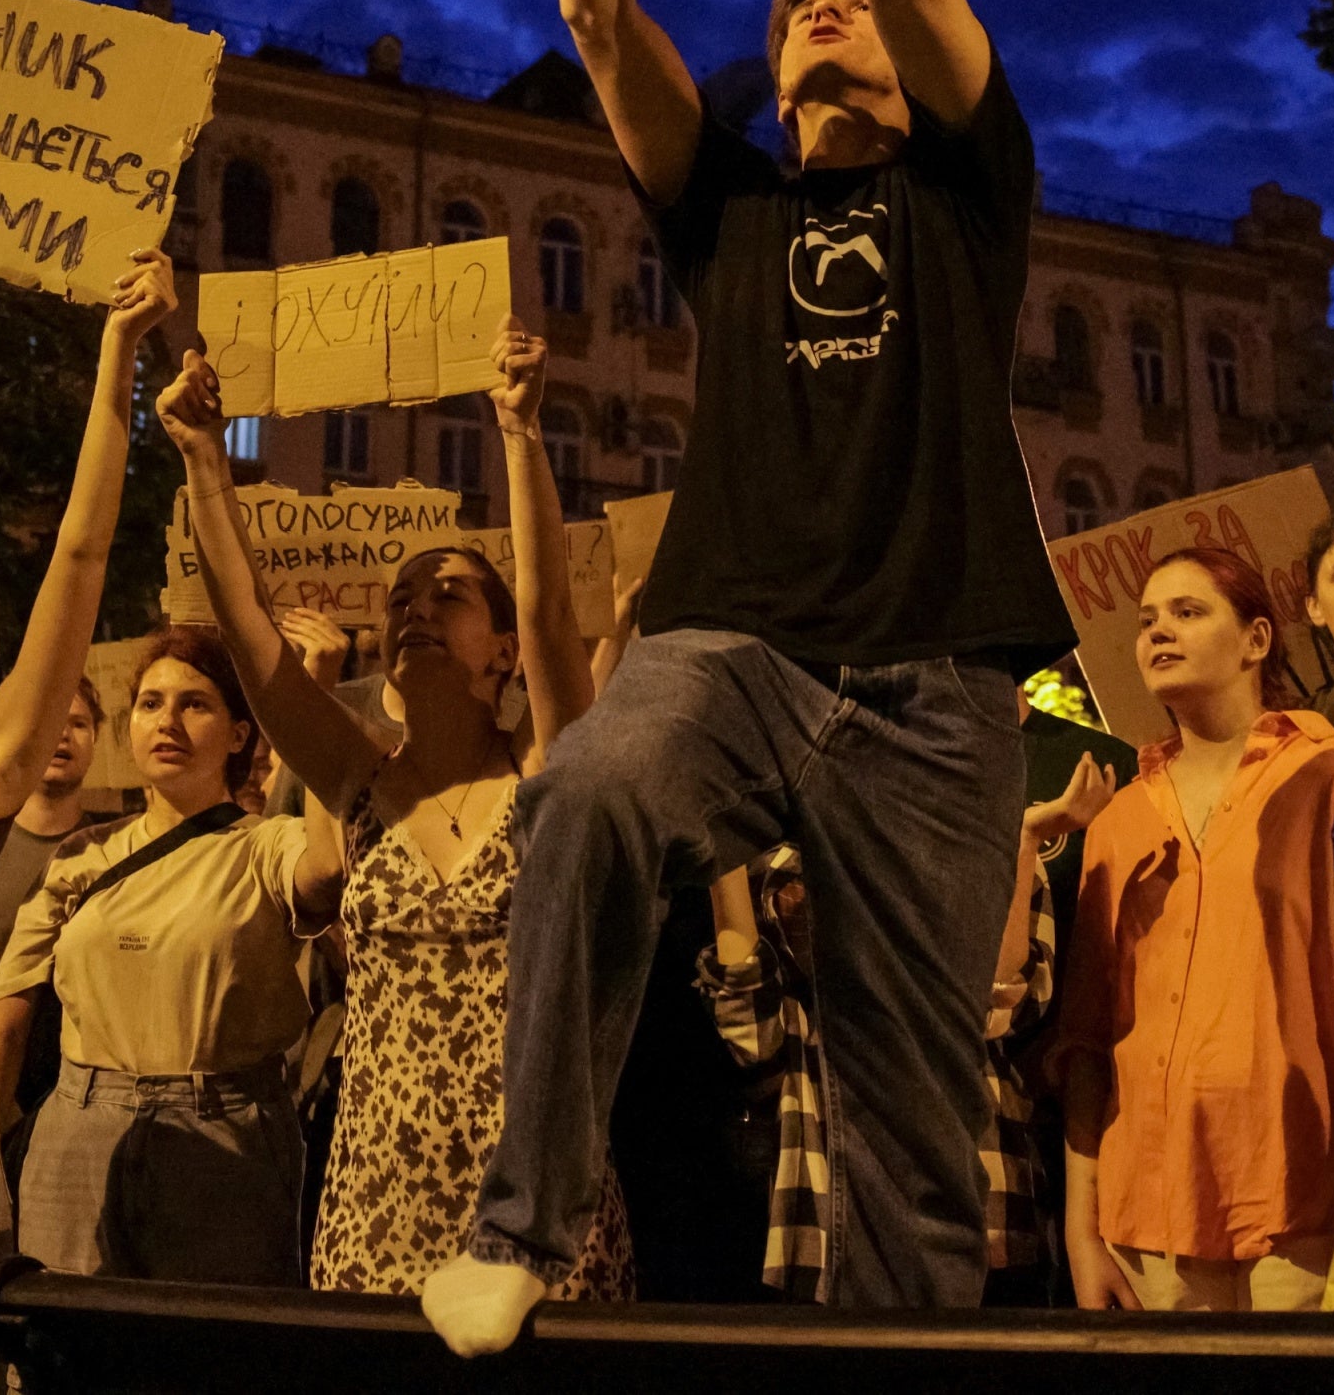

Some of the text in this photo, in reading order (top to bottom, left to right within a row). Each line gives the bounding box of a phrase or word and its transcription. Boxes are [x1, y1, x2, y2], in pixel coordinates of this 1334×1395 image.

[183, 499, 449, 540] ОГОЛОСУВАЛИ
[255, 541, 405, 573] ЗАВАЖАЛО
[1056, 526, 1160, 620] КРОК
